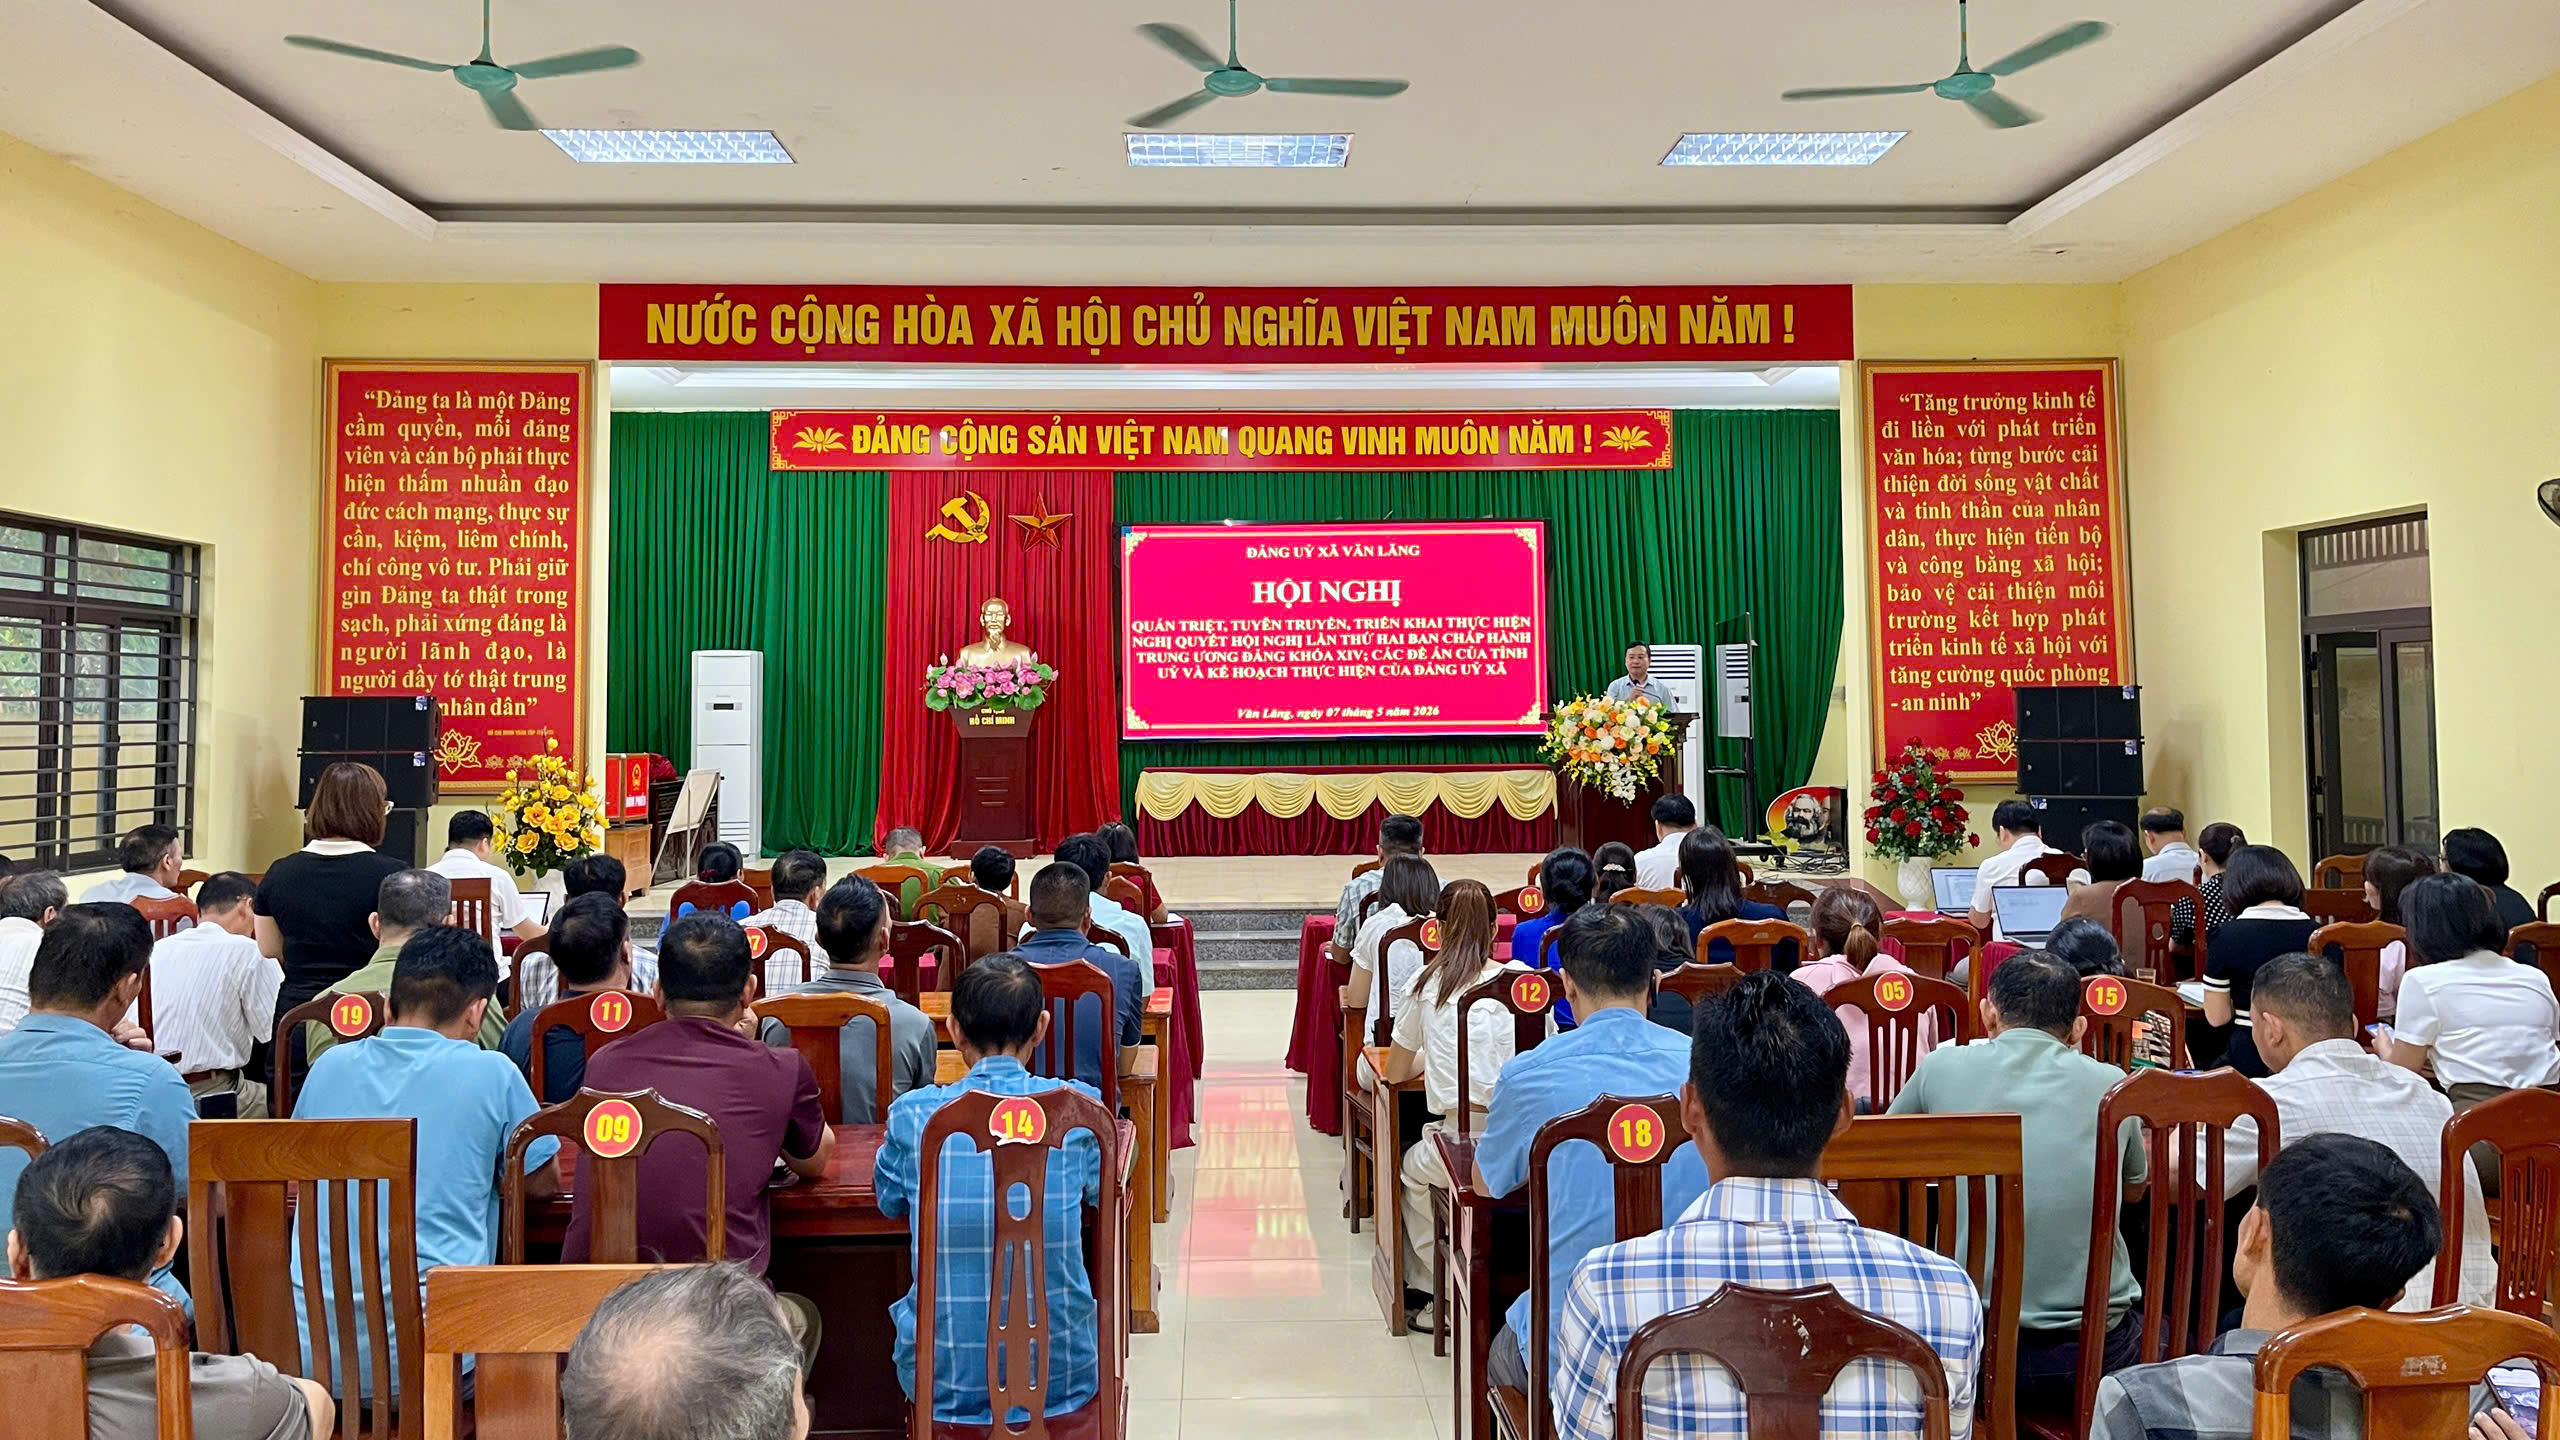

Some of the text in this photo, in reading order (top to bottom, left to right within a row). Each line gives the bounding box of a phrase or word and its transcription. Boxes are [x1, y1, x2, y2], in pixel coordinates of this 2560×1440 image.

[647, 292, 1794, 356] NƯỚC CỘNG HÒA XÃ HỘI CHỦ NGHĨA VIỆT NAM MUÔN NĂM !
[433, 393, 450, 408] ta
[456, 391, 472, 408] là
[479, 391, 514, 414] một
[521, 392, 570, 415] Đảng
[1963, 393, 2027, 414] trưởng
[2033, 392, 2073, 409] kinh
[2080, 385, 2095, 408] tế
[852, 415, 1592, 461] ĐẢNG CỘNG SẢN VIỆT NAM QUANG VINH MUÔN NĂM !
[345, 445, 569, 470] viên và cán bộ phải thực
[1883, 444, 2097, 469] văn hóa; từng bước cải
[344, 501, 570, 525] đức cách mạng, thực sự
[1884, 495, 2100, 520] và tinh thần của nhân
[343, 557, 569, 581] chí công vô tư. Phải giữ
[1886, 549, 2102, 578] và công bằng xã hội;
[1252, 577, 1401, 609] HỘI NGHỊ
[341, 613, 567, 637] sạch, phải xứng đáng là
[1888, 604, 2105, 633] trường kết hợp phát
[1231, 634, 1259, 649] HỘI
[1889, 631, 2107, 659] triển kinh tế xã hội với
[341, 664, 566, 694] người đầy tớ thật trung
[1890, 658, 2109, 688] tăng cường quốc phòng
[438, 697, 485, 716] nhân
[1326, 707, 1341, 717] 07
[1376, 707, 1384, 717] 5
[1413, 706, 1440, 716] 2026
[1902, 698, 1924, 711] an
[995, 716, 1015, 725] MINH
[1524, 894, 1538, 907] 01
[1519, 983, 1541, 1002] 12
[1882, 981, 1905, 1001] 05
[2095, 986, 2118, 1006] 15
[340, 1005, 363, 1025] 19
[601, 1001, 622, 1022] 11
[596, 1113, 631, 1143] 09
[1001, 1109, 1034, 1138] 14
[1619, 1119, 1652, 1147] 18
